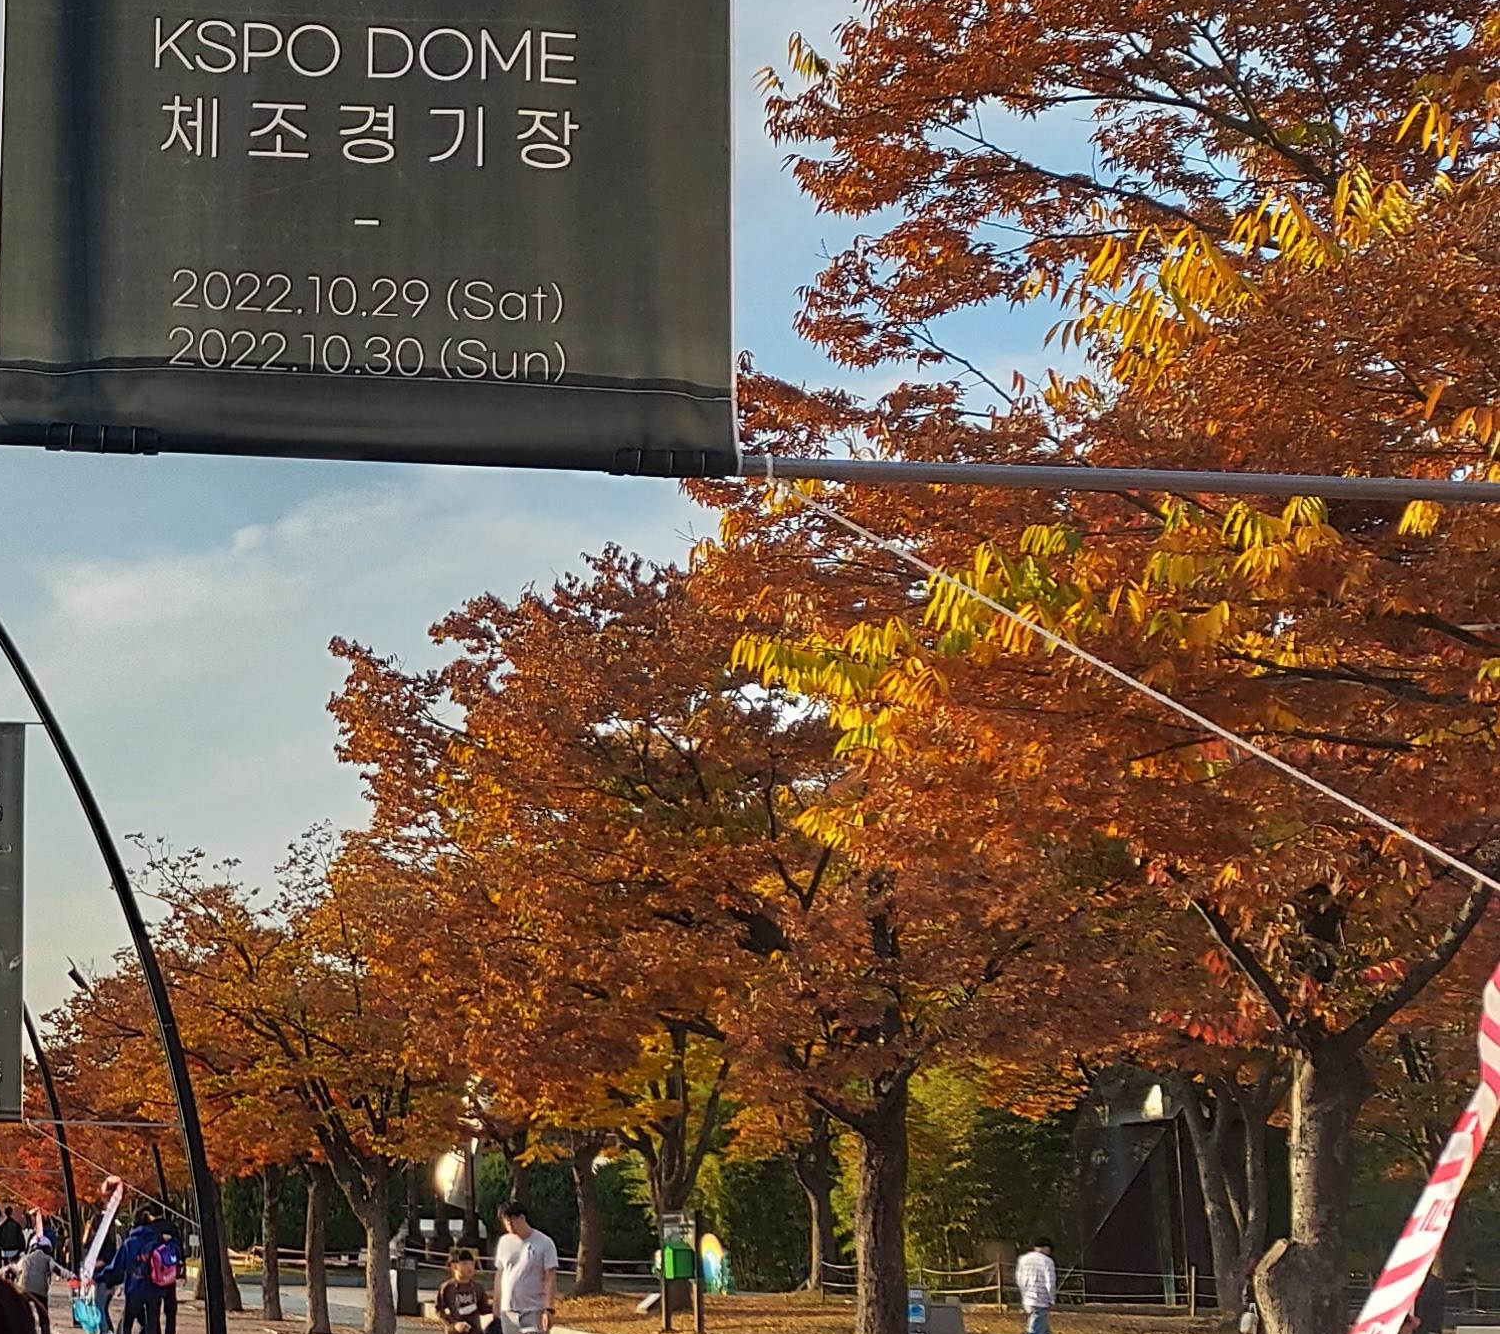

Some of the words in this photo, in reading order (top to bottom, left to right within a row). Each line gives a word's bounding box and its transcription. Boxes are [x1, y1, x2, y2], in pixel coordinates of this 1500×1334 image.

[154, 16, 342, 78] KSPO
[366, 26, 578, 86] DOME
[159, 94, 580, 169] 체조경기장
[171, 268, 431, 319] 2022.10.29
[446, 277, 566, 324] (Sat)
[167, 326, 426, 378] 2022.10.30
[439, 339, 568, 383] (Sun)
